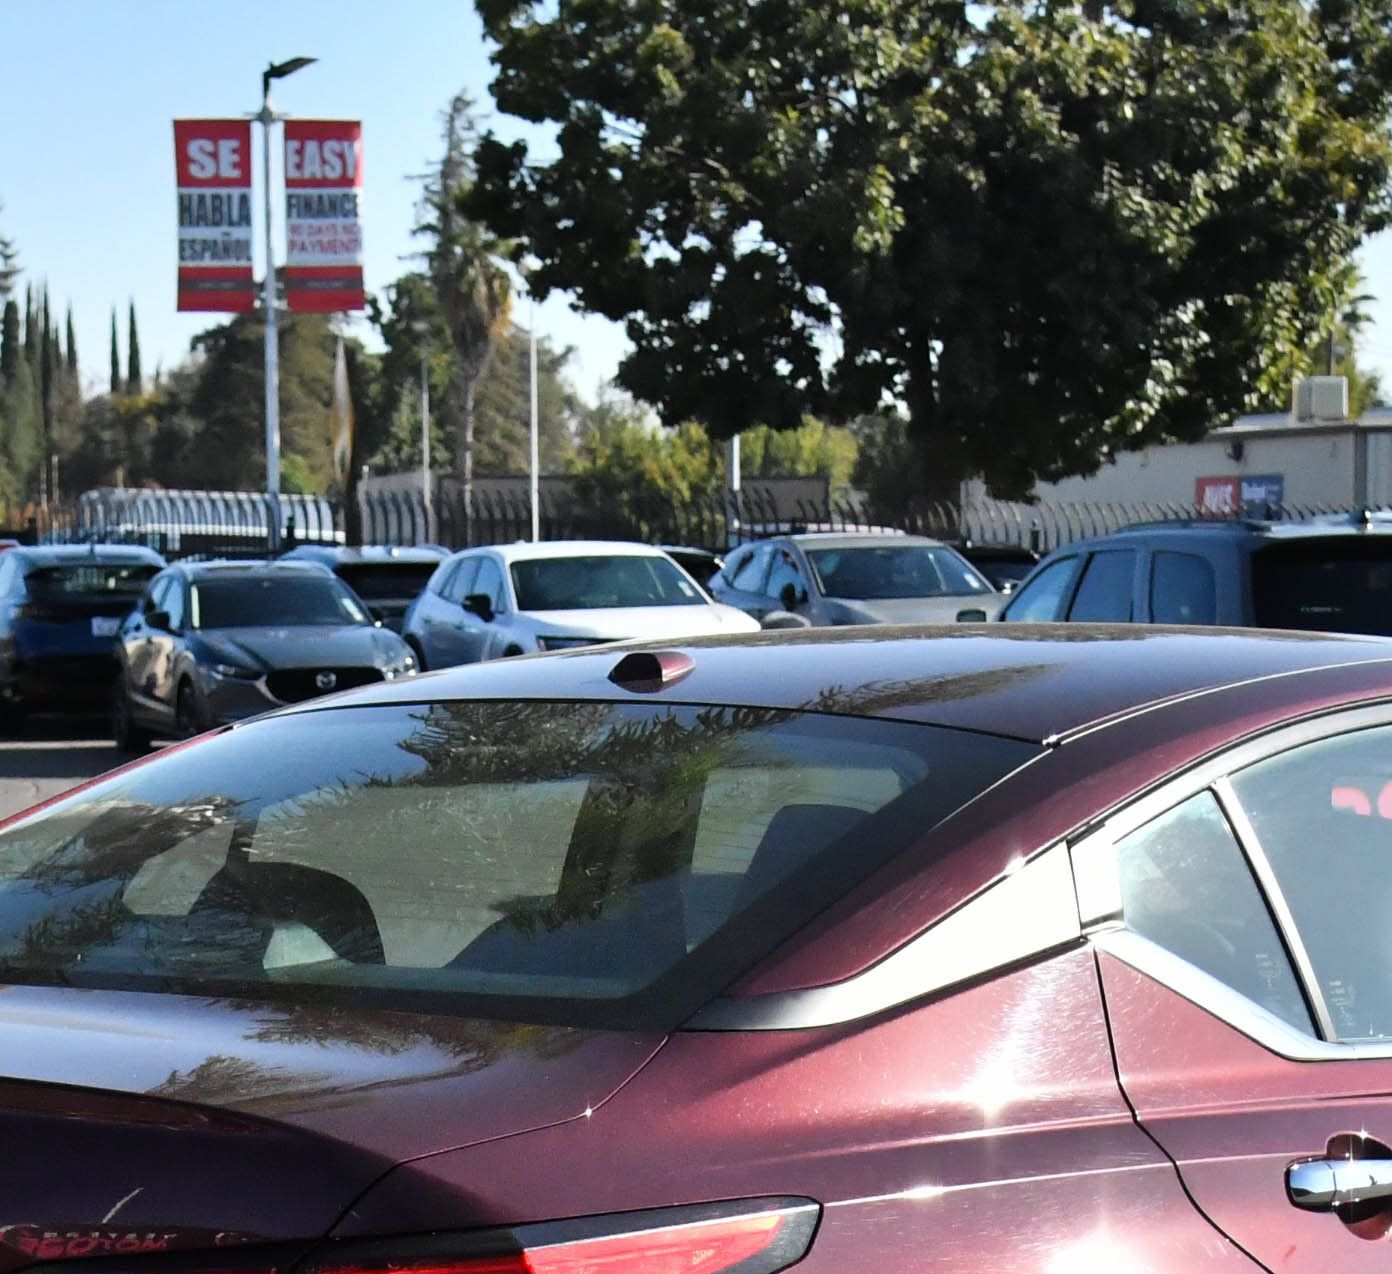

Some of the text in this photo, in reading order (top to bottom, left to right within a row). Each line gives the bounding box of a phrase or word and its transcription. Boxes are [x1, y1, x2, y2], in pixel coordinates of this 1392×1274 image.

[186, 138, 242, 180] SE
[285, 139, 356, 180] EASY
[179, 193, 251, 227] HABLA
